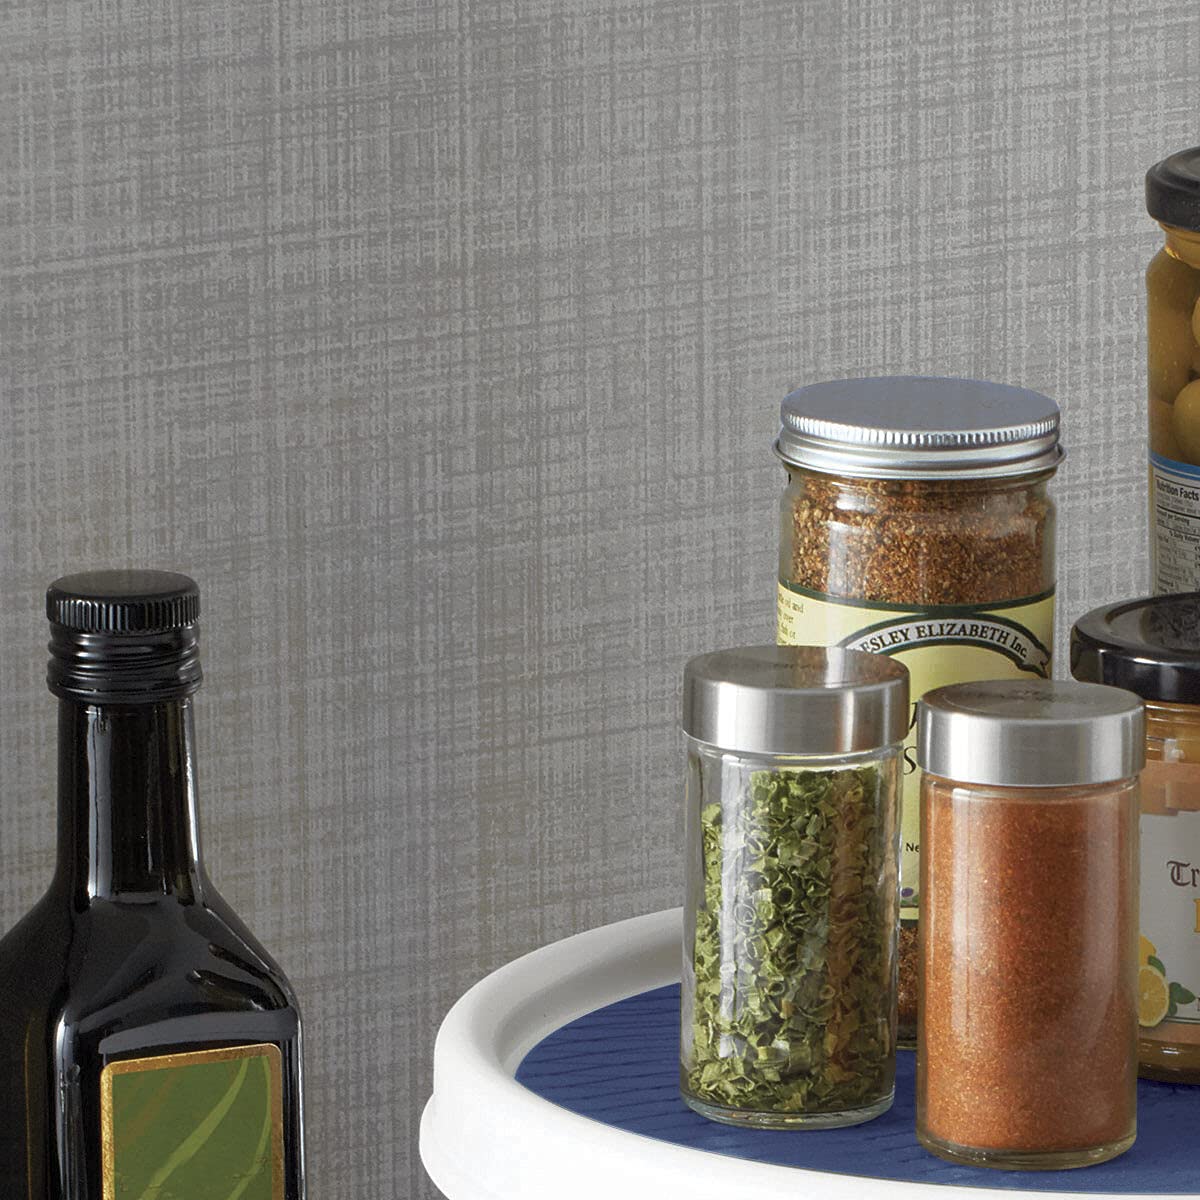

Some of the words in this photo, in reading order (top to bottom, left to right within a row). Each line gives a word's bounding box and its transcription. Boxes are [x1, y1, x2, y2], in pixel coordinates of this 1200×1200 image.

[1180, 488, 1200, 501] Facts
[858, 628, 911, 653] ESLEY
[916, 623, 1011, 644] ELIZABETH
[1010, 636, 1028, 658] Inc.
